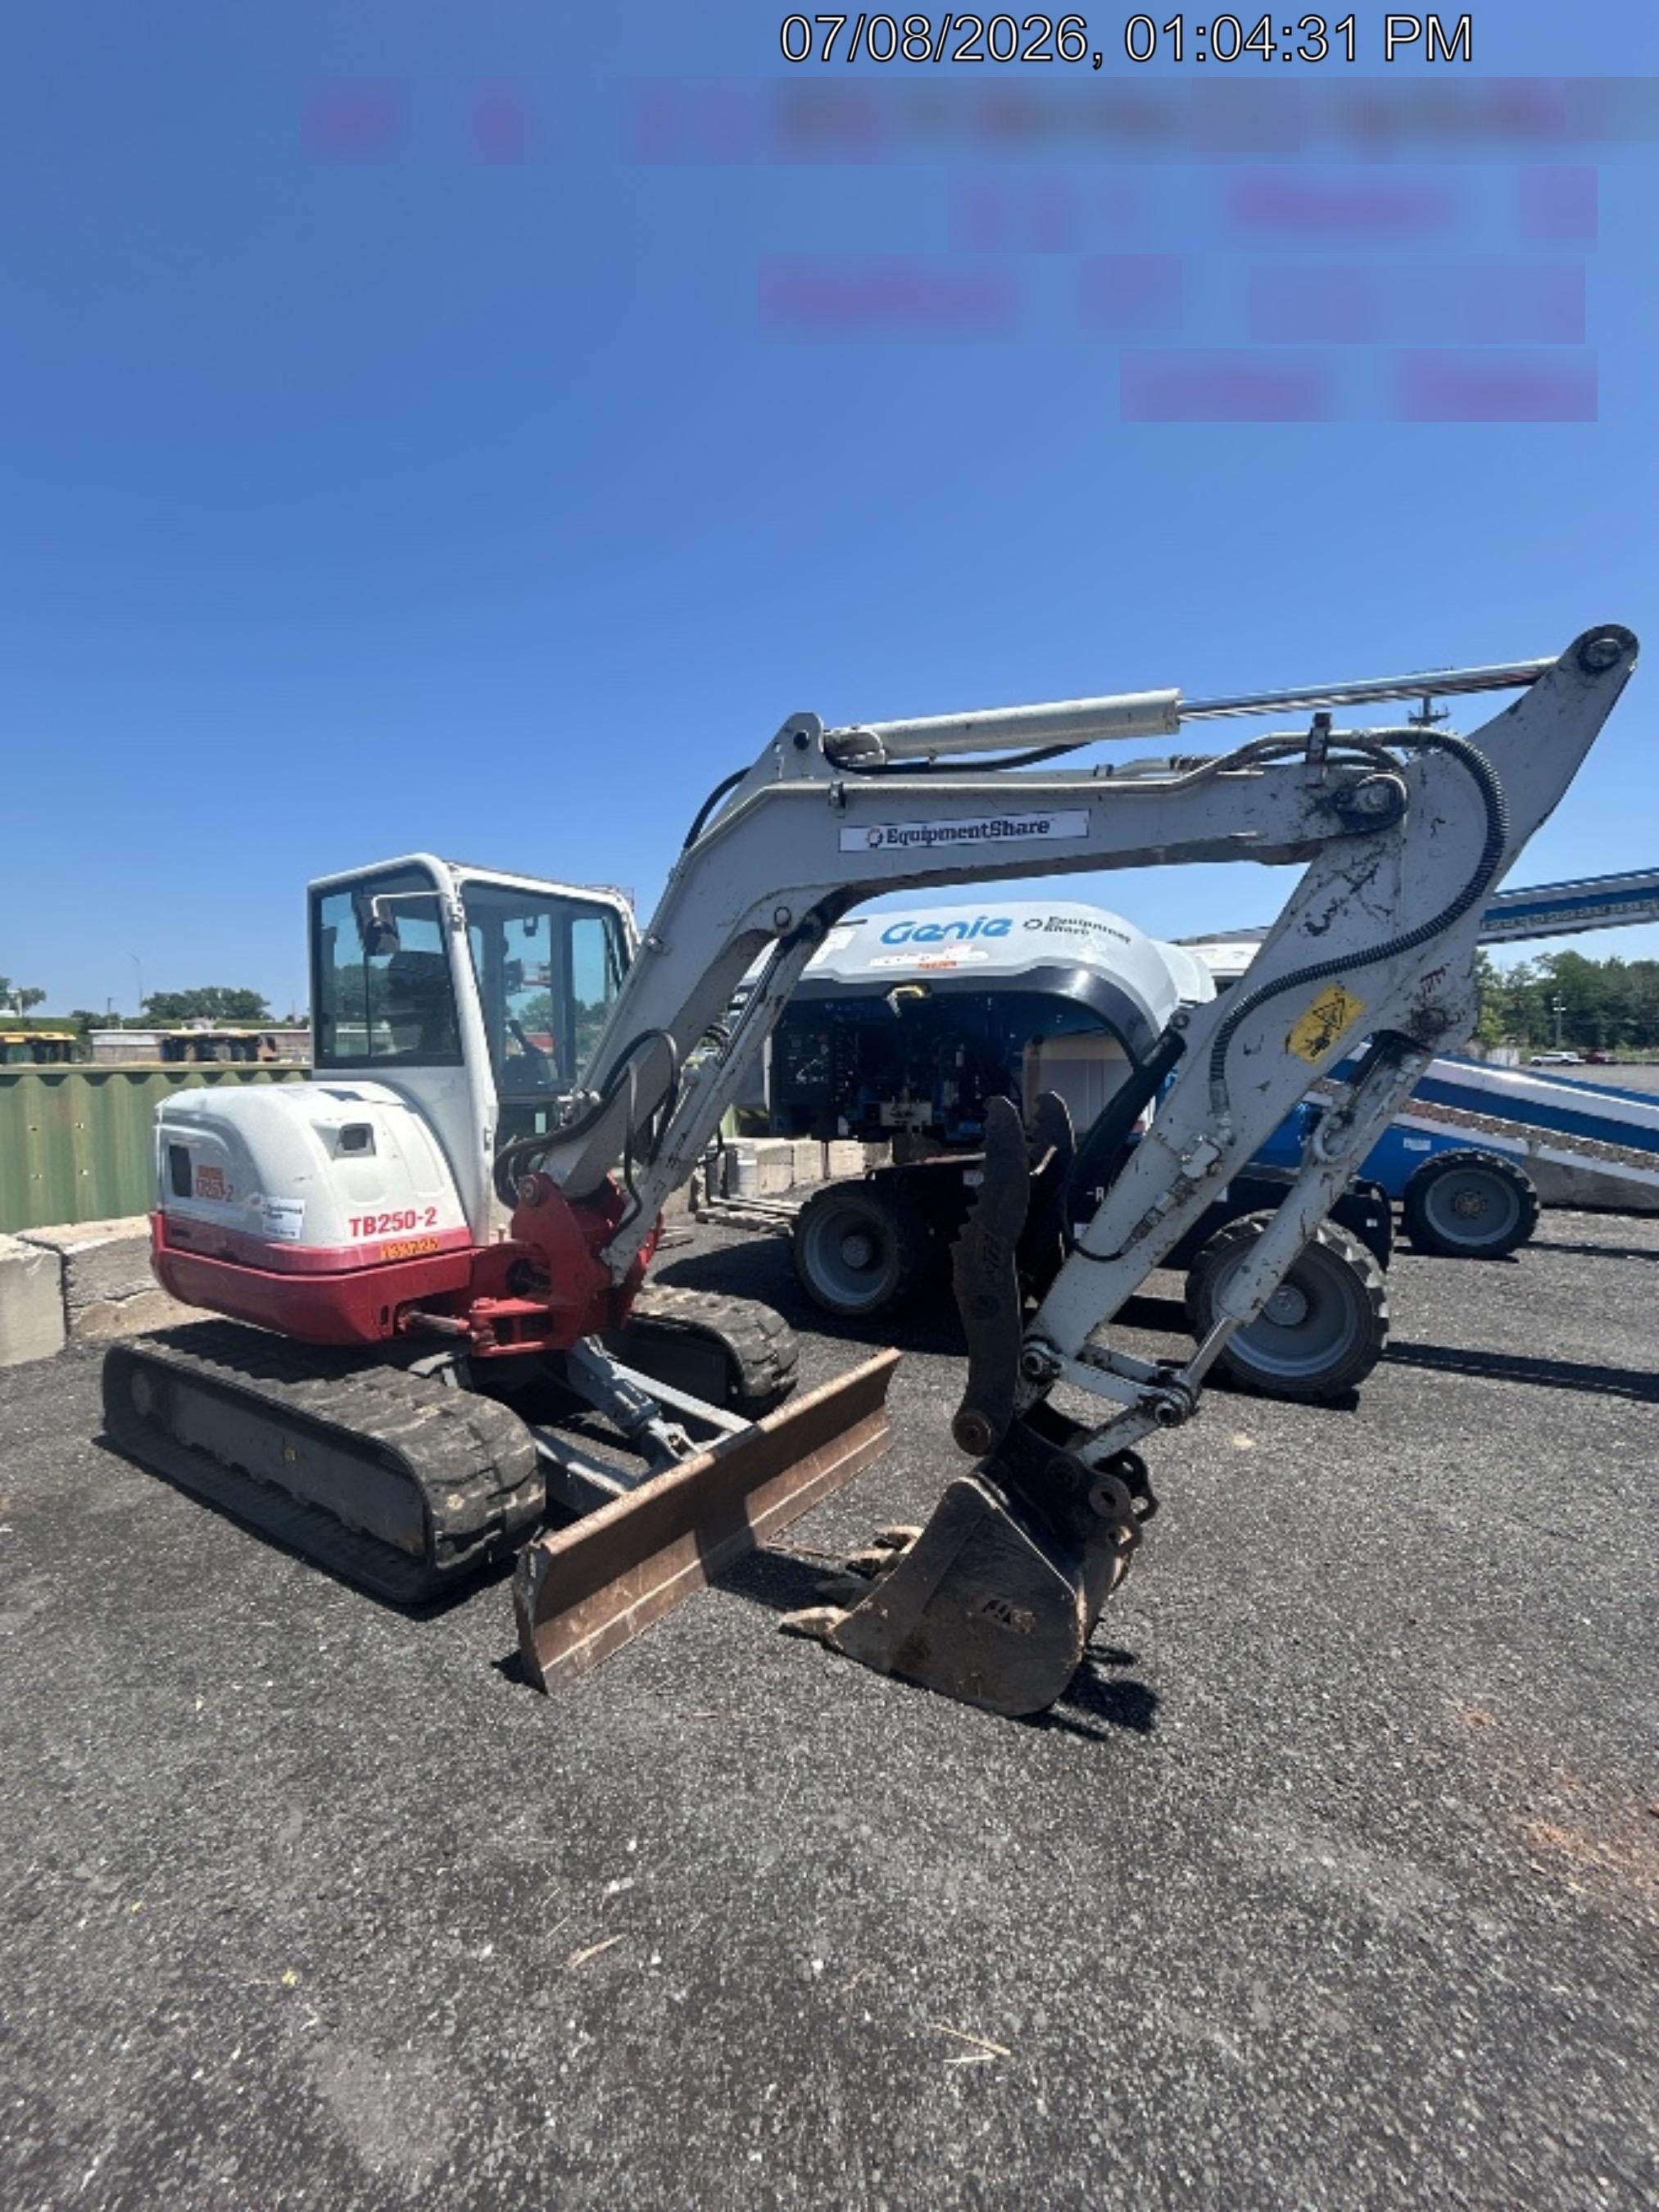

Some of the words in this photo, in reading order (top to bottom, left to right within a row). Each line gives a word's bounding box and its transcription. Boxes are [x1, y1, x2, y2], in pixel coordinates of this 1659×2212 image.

[886, 820, 1050, 845] EquipmentShare
[880, 915, 1013, 944] Genie
[348, 1206, 437, 1236] TB250-2
